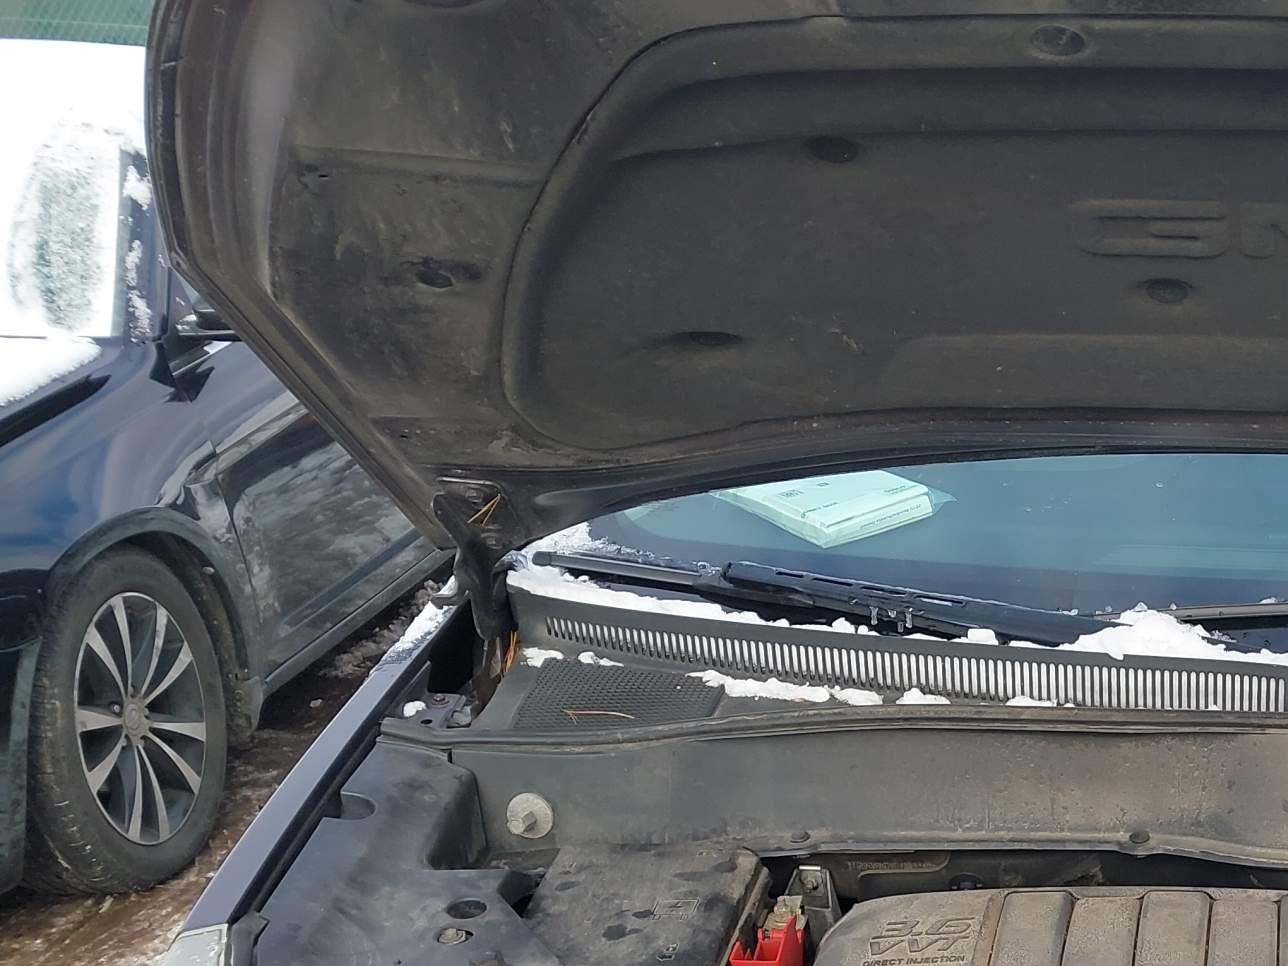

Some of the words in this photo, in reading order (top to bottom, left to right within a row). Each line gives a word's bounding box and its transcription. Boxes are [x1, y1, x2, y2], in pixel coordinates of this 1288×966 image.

[871, 916, 976, 940] 3.6
[869, 935, 970, 957] VVT
[905, 954, 966, 966] INJECTION
